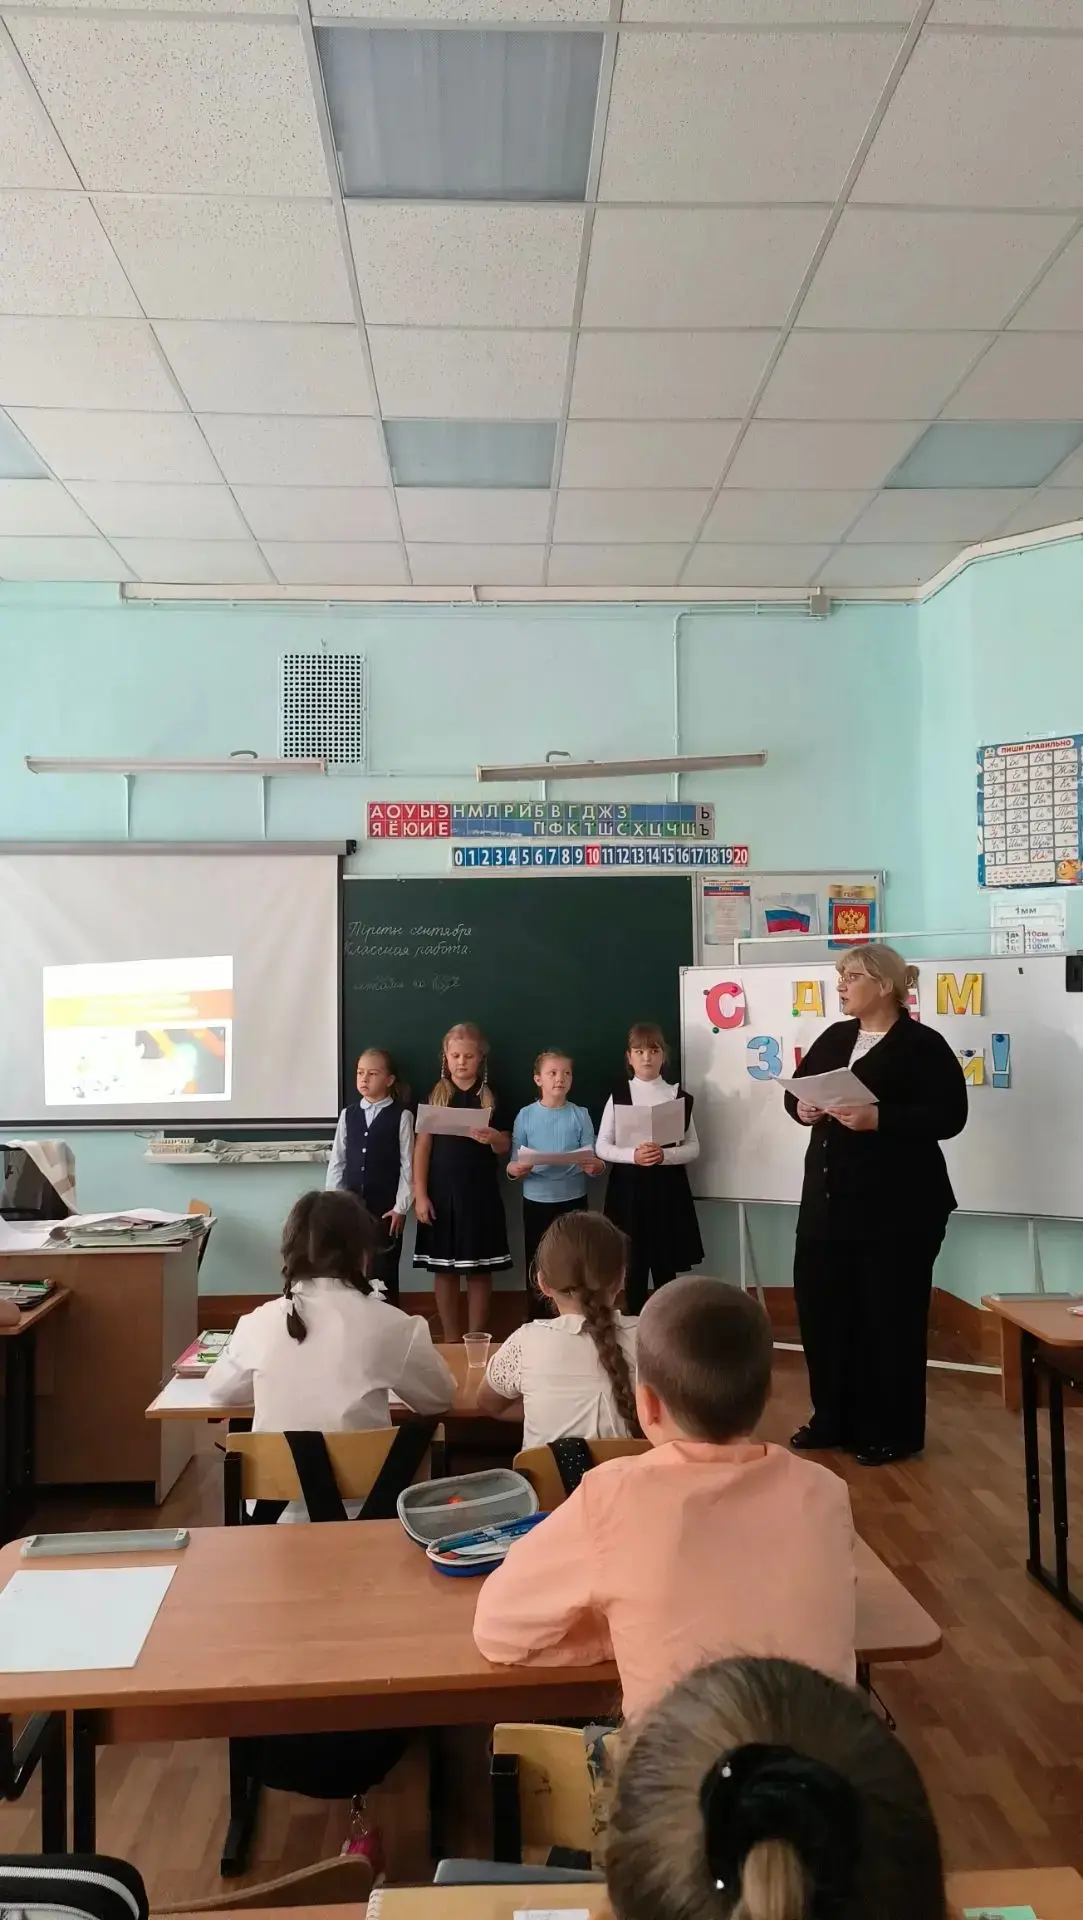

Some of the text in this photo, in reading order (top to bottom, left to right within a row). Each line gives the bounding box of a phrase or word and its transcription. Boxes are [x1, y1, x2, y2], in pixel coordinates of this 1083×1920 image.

[1026, 740, 1071, 750] ПРАВИЛЬНО
[454, 847, 748, 865] 0 1 2 3 4 5 6 7 8 9 10 11 12 13 14 15 16 17 18 19 20
[410, 923, 472, 943] сентября
[344, 941, 410, 956] Классная
[706, 973, 984, 1029] С ДМ
